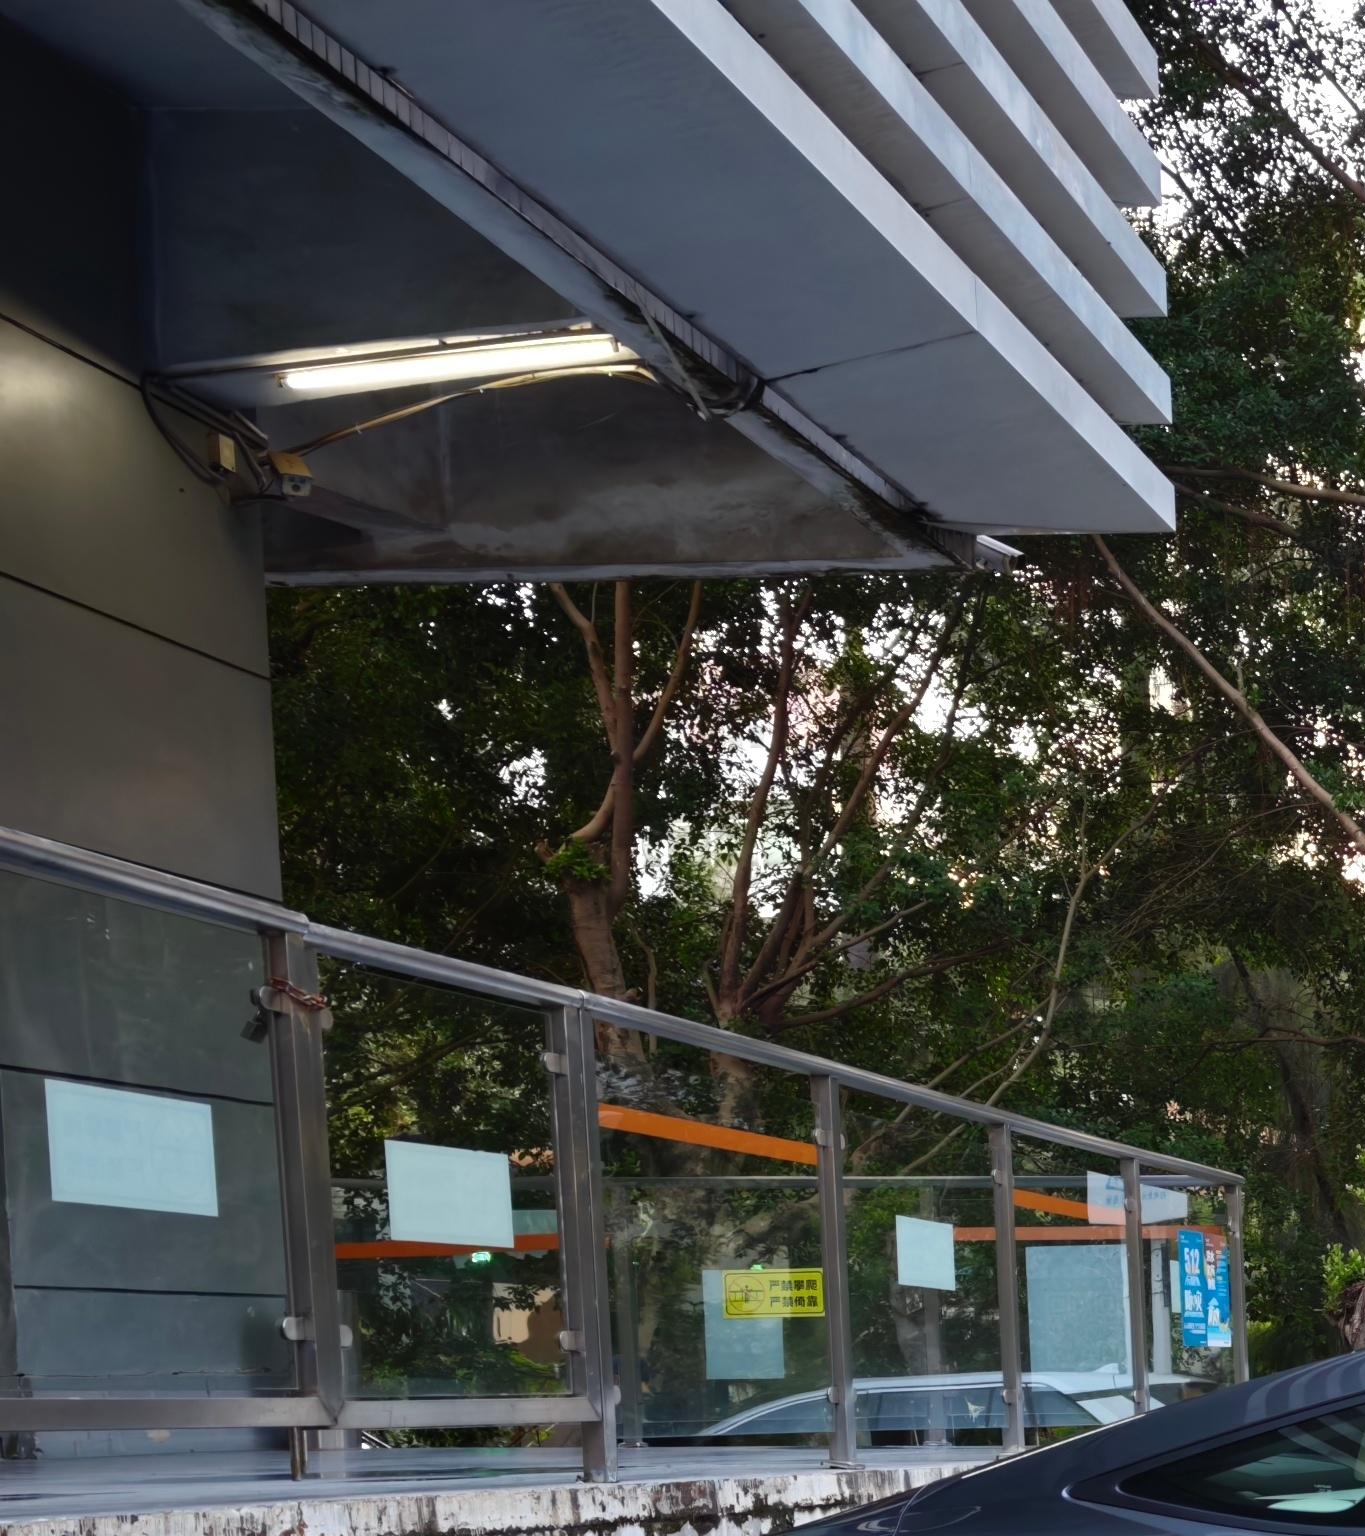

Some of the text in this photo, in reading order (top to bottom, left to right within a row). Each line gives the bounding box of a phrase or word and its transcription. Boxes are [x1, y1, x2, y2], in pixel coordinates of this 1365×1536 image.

[769, 1279, 818, 1291] 严禁攀爬
[769, 1295, 818, 1308] 严禁倚靠
